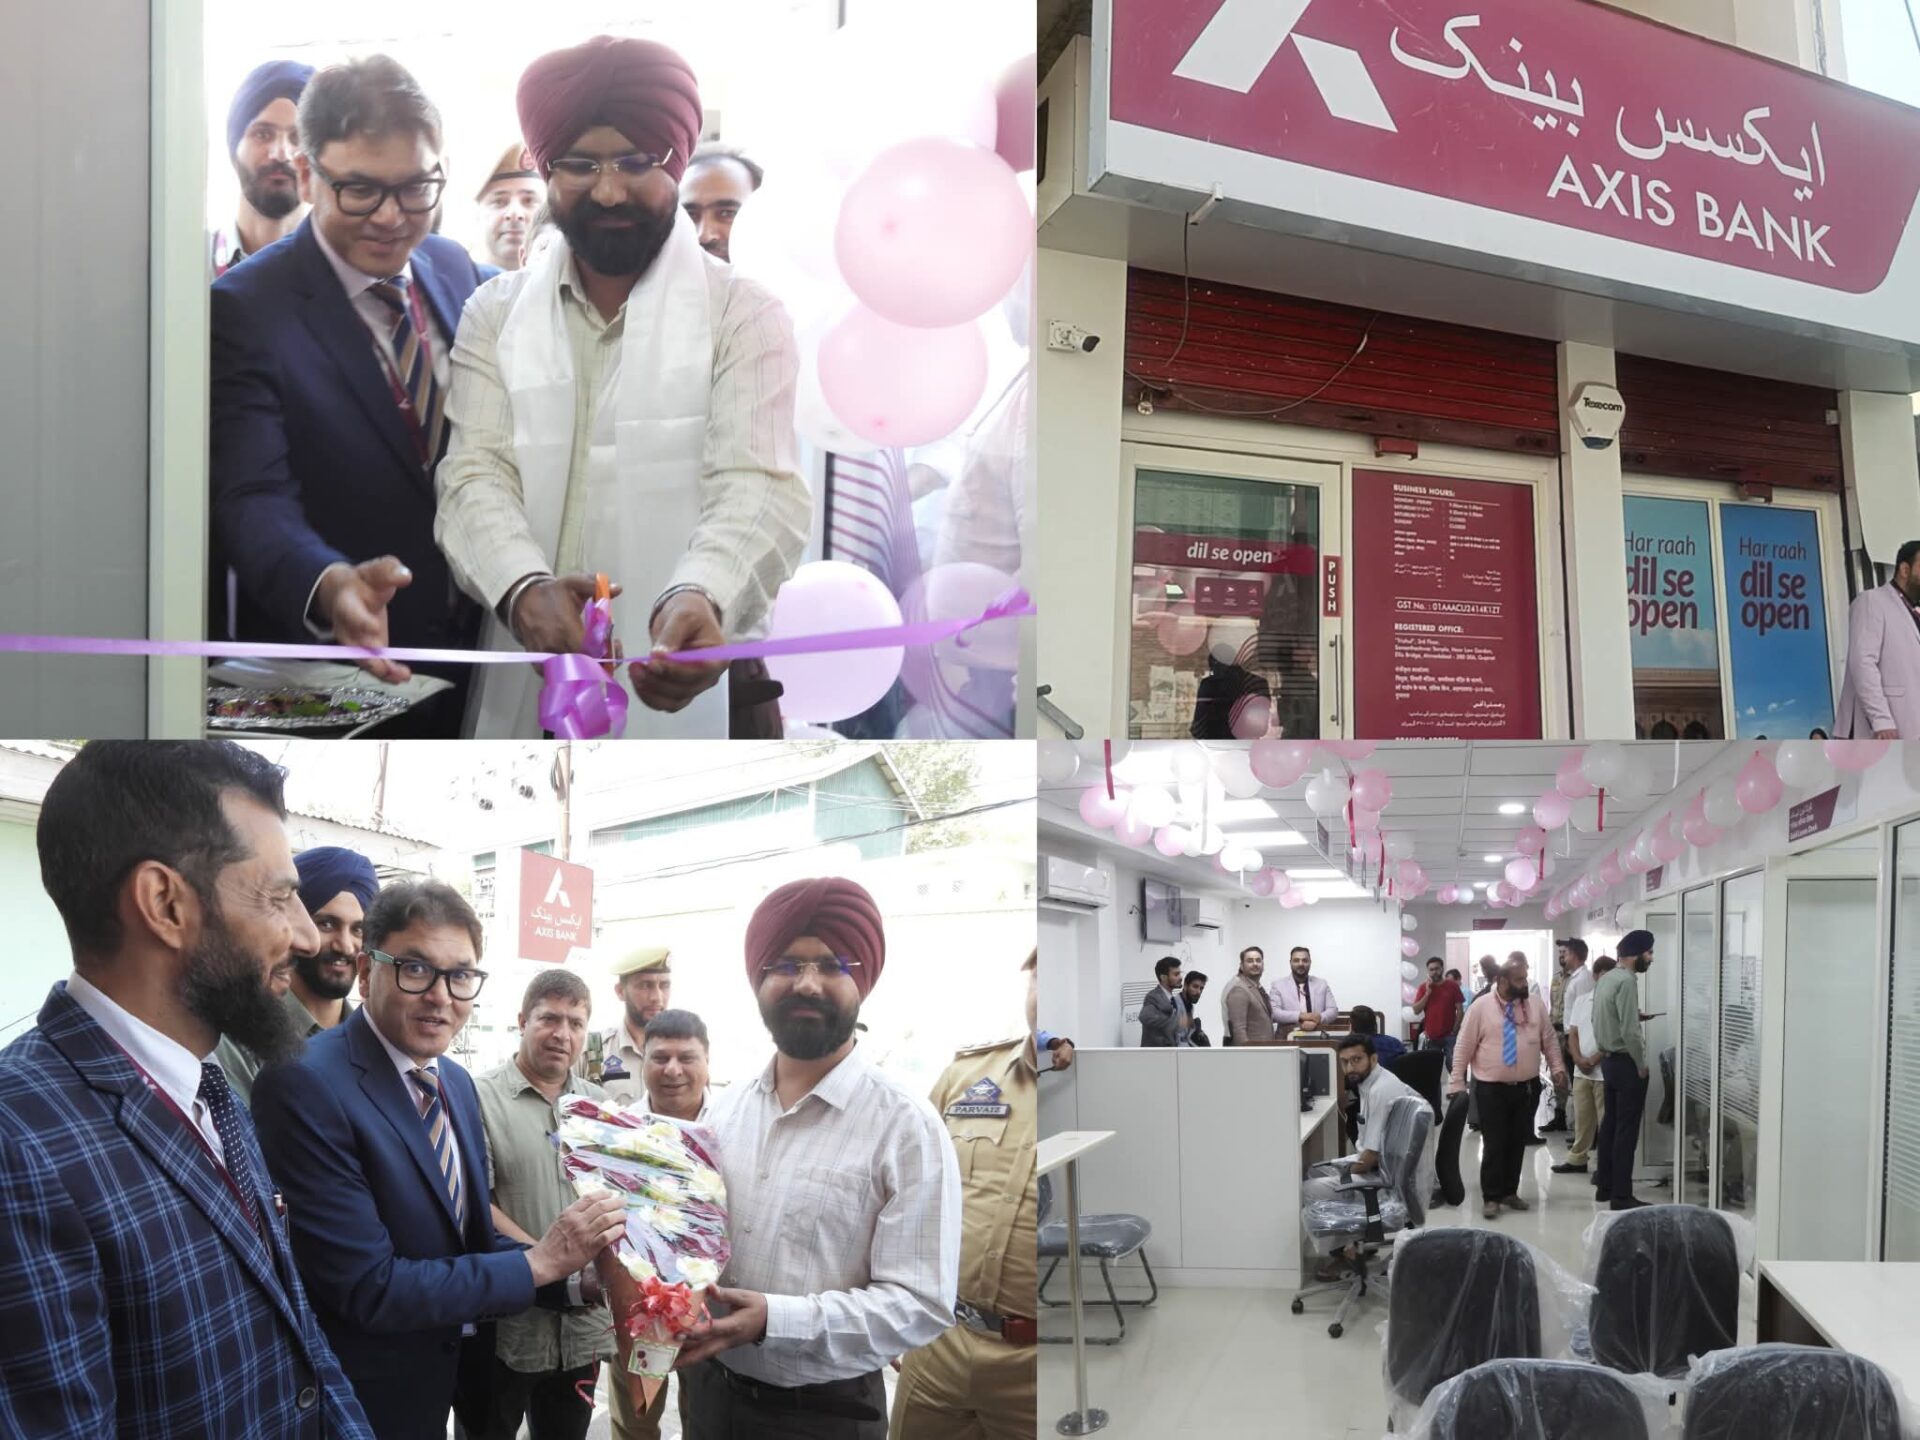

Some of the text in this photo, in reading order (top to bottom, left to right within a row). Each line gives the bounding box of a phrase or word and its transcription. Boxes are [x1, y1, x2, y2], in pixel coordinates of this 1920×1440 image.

[1389, 15, 1585, 138] بینک
[1546, 154, 1836, 268] AXIS BANK
[1394, 484, 1427, 494] BUSINESS
[1187, 542, 1272, 564] dil se open
[1657, 536, 1696, 556] raah
[1739, 535, 1807, 560] Har raah
[1328, 561, 1336, 611] PUSH
[1627, 555, 1694, 598] dil se
[1740, 560, 1806, 600] dil se
[1397, 600, 1411, 609] GST
[1628, 599, 1697, 636] open
[1741, 601, 1809, 636] open
[1394, 623, 1436, 632] REGISTERED
[534, 926, 577, 941] AXIS BANK
